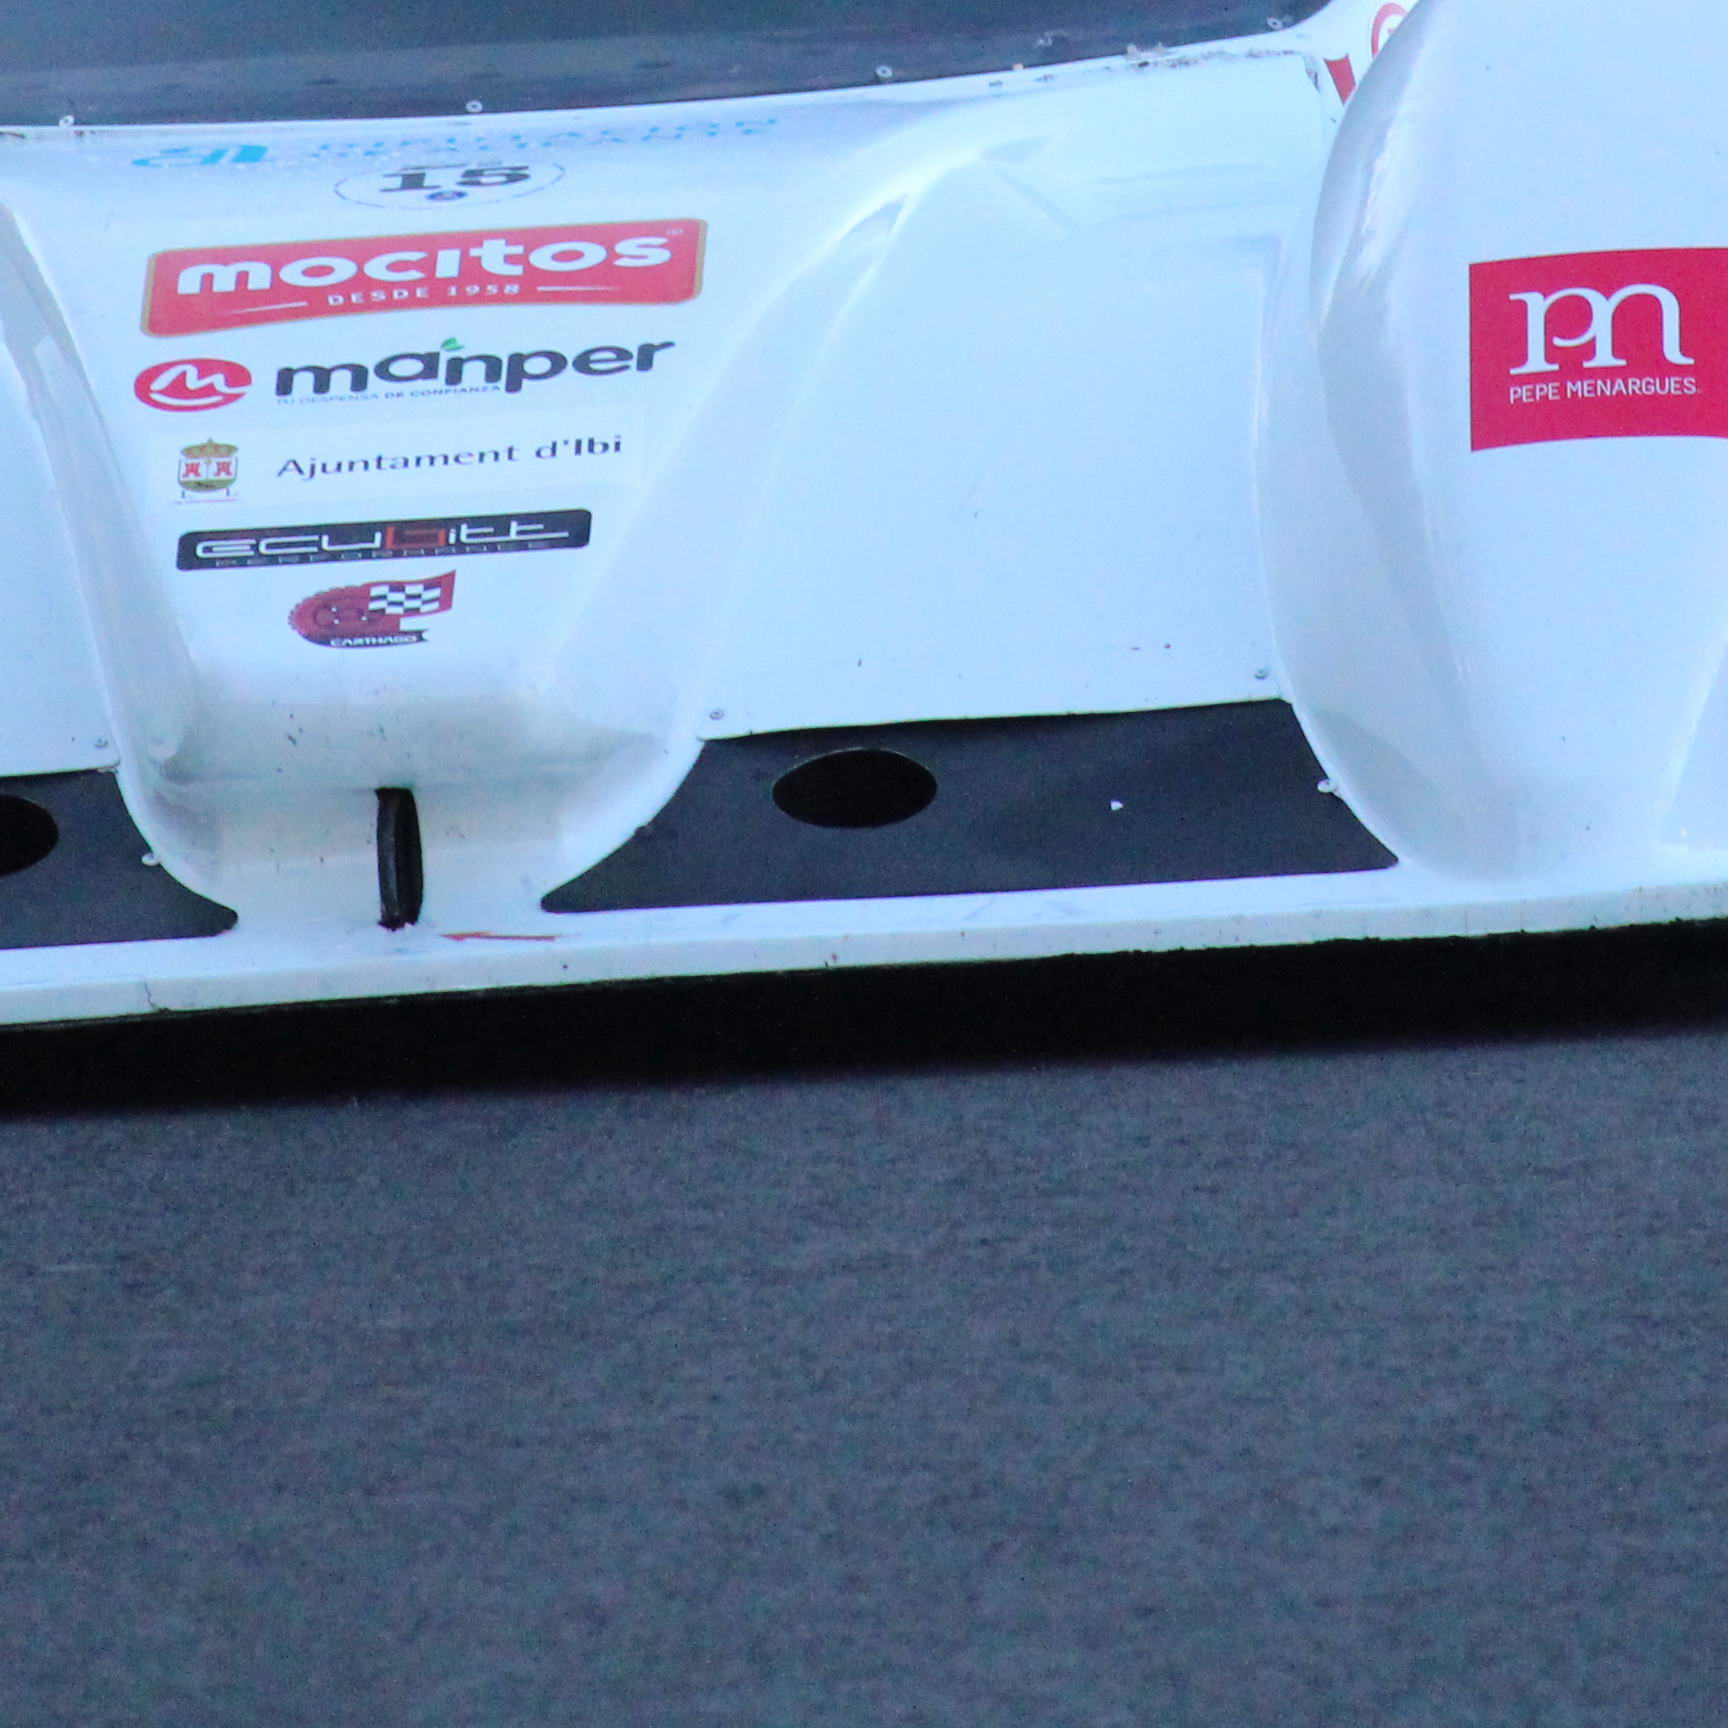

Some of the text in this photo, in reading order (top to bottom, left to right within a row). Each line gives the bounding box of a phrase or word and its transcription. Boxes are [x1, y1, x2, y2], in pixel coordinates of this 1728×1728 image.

[378, 165, 531, 193] 15
[176, 235, 672, 296] mocitos
[327, 286, 429, 307] DESDE
[275, 340, 676, 396] manper
[384, 391, 407, 399] DE
[414, 385, 502, 398] CONFIANZA
[1509, 376, 1698, 405] PEPE MENARGUES
[276, 434, 623, 482] Ajuntament d'Ibi
